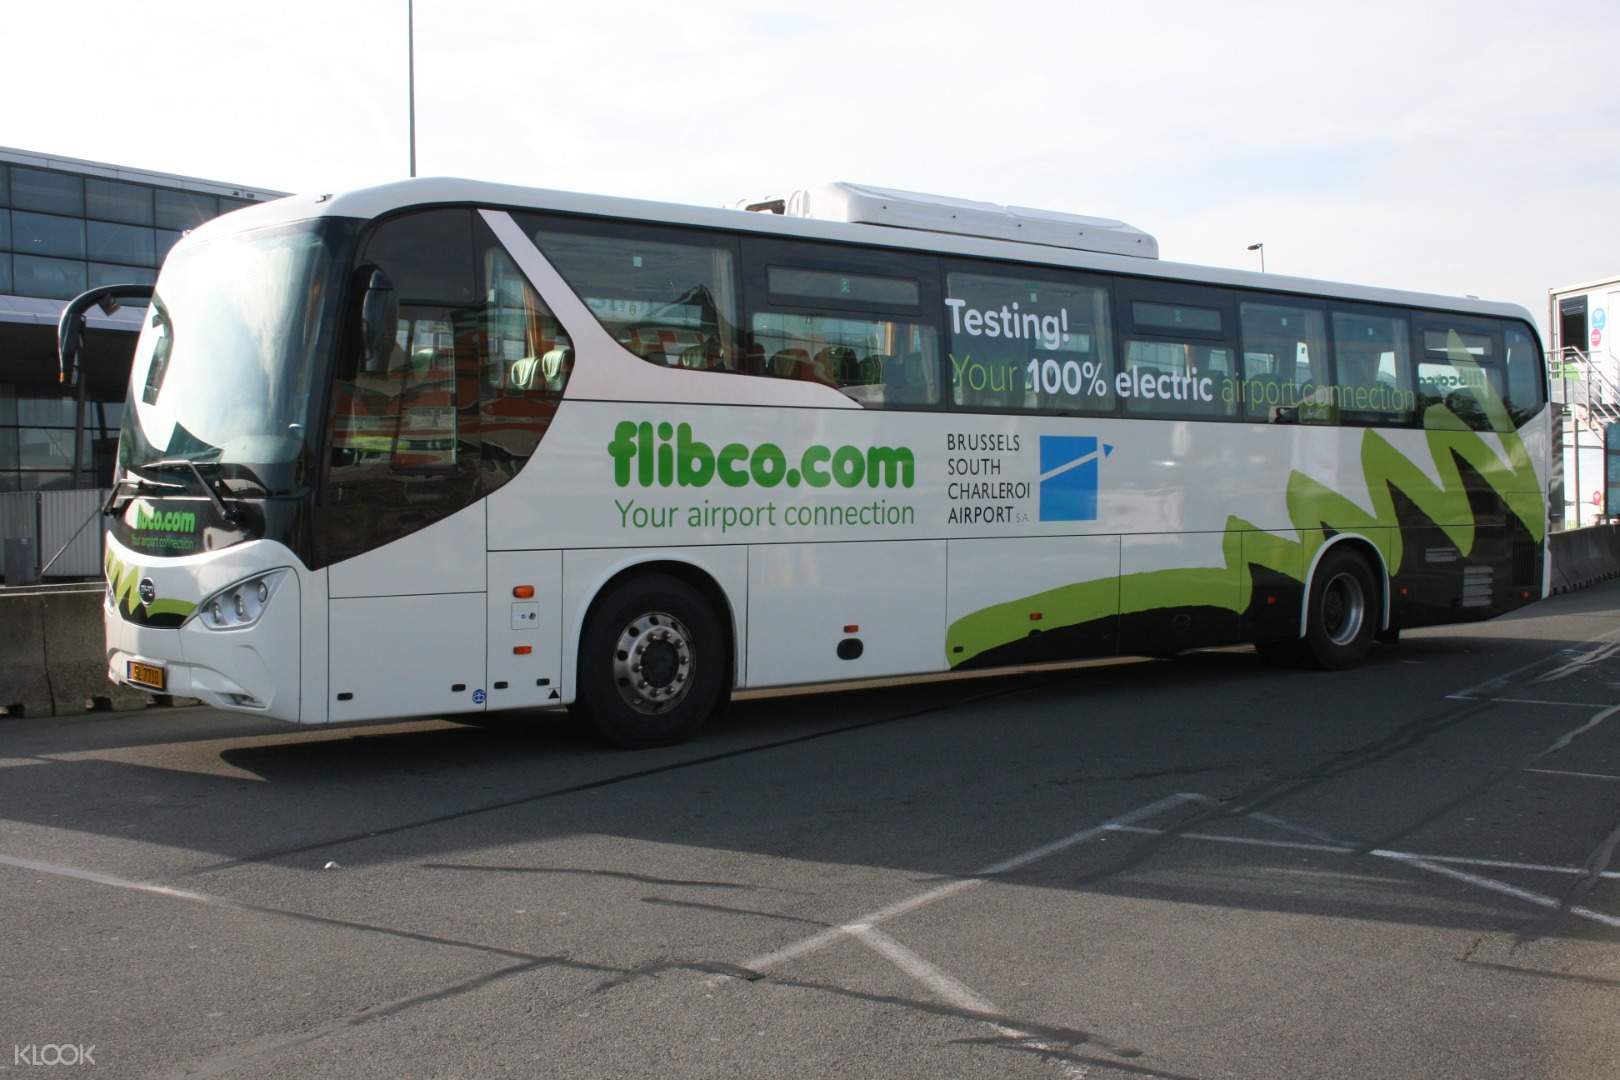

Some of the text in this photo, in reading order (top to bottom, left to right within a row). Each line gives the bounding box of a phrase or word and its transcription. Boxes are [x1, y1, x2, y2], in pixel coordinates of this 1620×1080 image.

[945, 298, 1070, 350] Testing!
[949, 353, 1415, 411] Your 100% electric airport connection
[607, 421, 915, 488] flibco.com
[947, 434, 1020, 451] BRUSSELS
[948, 458, 1001, 475] SOUTH
[948, 482, 1030, 500] CHARLEROI
[615, 499, 914, 533] Your airport connection
[948, 506, 1014, 524] AIRPORT
